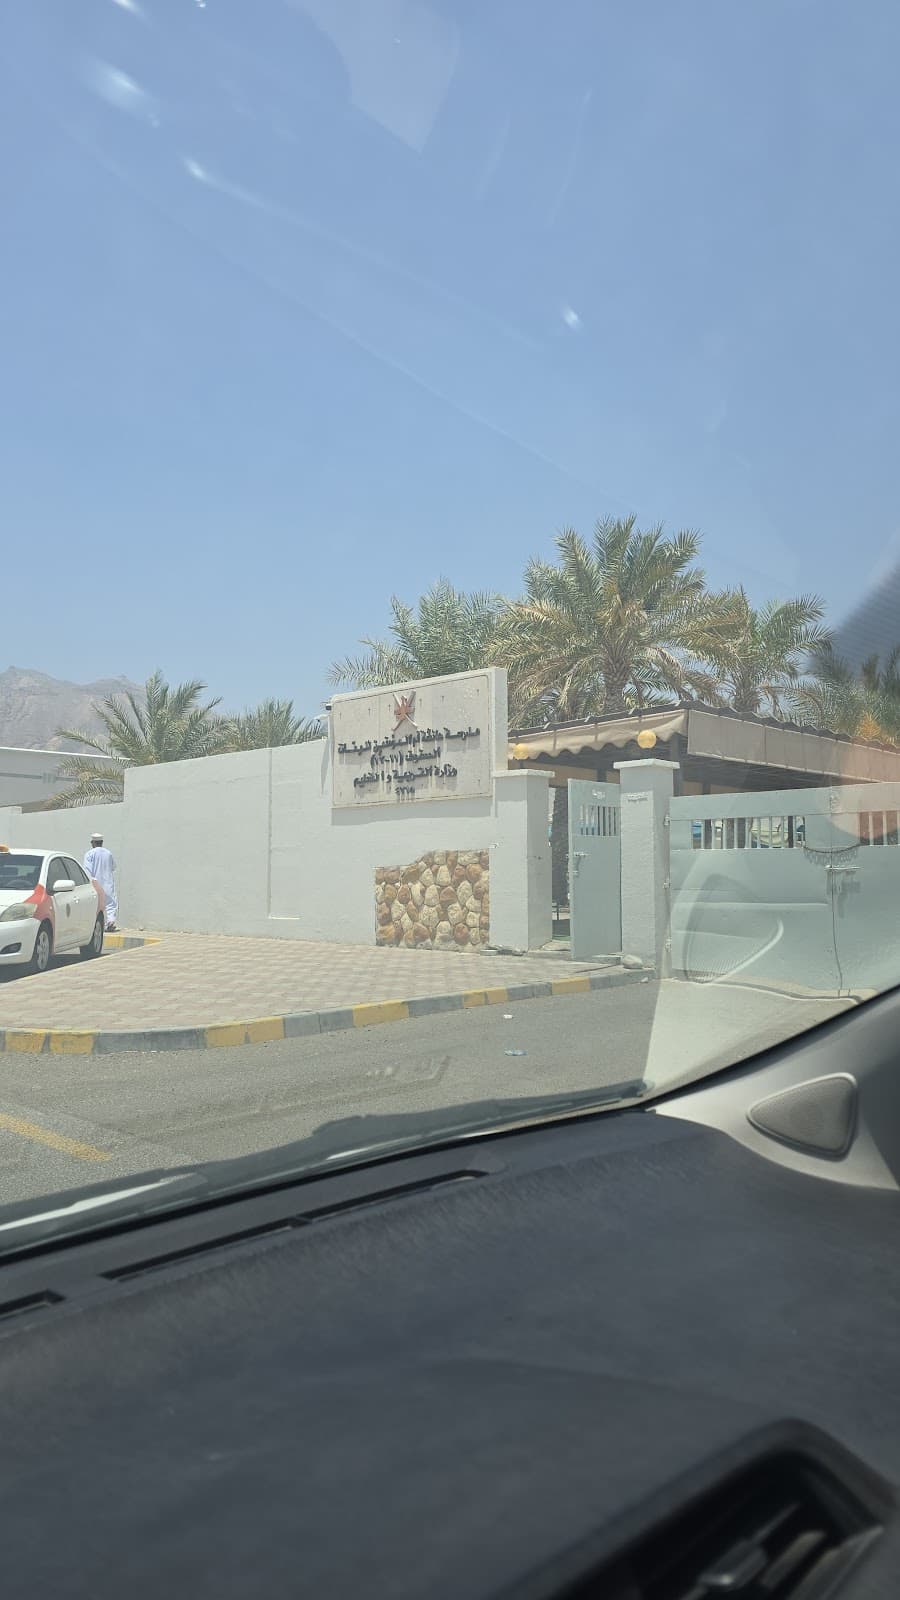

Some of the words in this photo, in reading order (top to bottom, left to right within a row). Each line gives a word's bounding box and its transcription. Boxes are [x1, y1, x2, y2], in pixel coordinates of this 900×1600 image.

[443, 726, 480, 740] مدرسة
[337, 740, 371, 756] للبنات
[405, 746, 441, 763] الصفوف
[391, 766, 433, 782] التربية
[434, 763, 458, 777] وزارة
